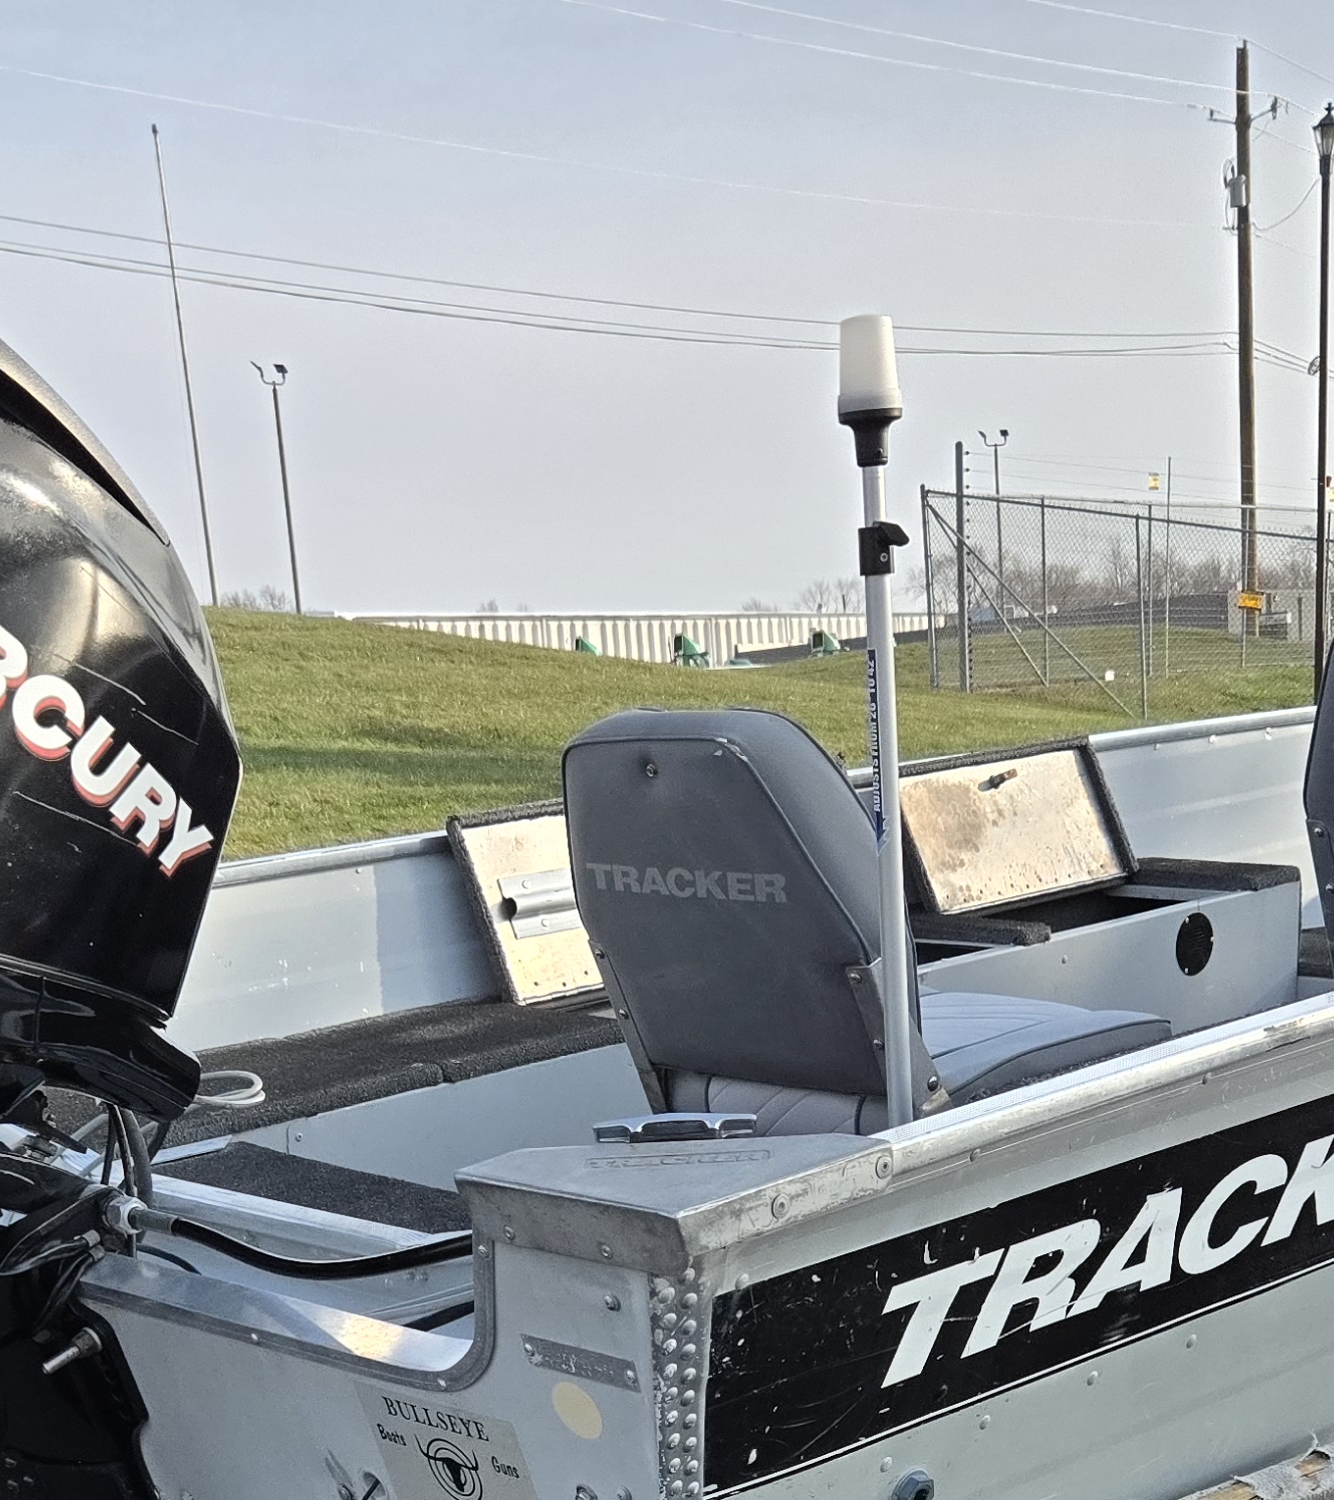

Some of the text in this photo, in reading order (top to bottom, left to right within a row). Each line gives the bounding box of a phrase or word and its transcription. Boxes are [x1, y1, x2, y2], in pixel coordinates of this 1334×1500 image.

[586, 862, 788, 903] TRACKER
[376, 1423, 408, 1447] Boats
[381, 1395, 490, 1443] BULLSEYE
[491, 1455, 520, 1479] Guns
